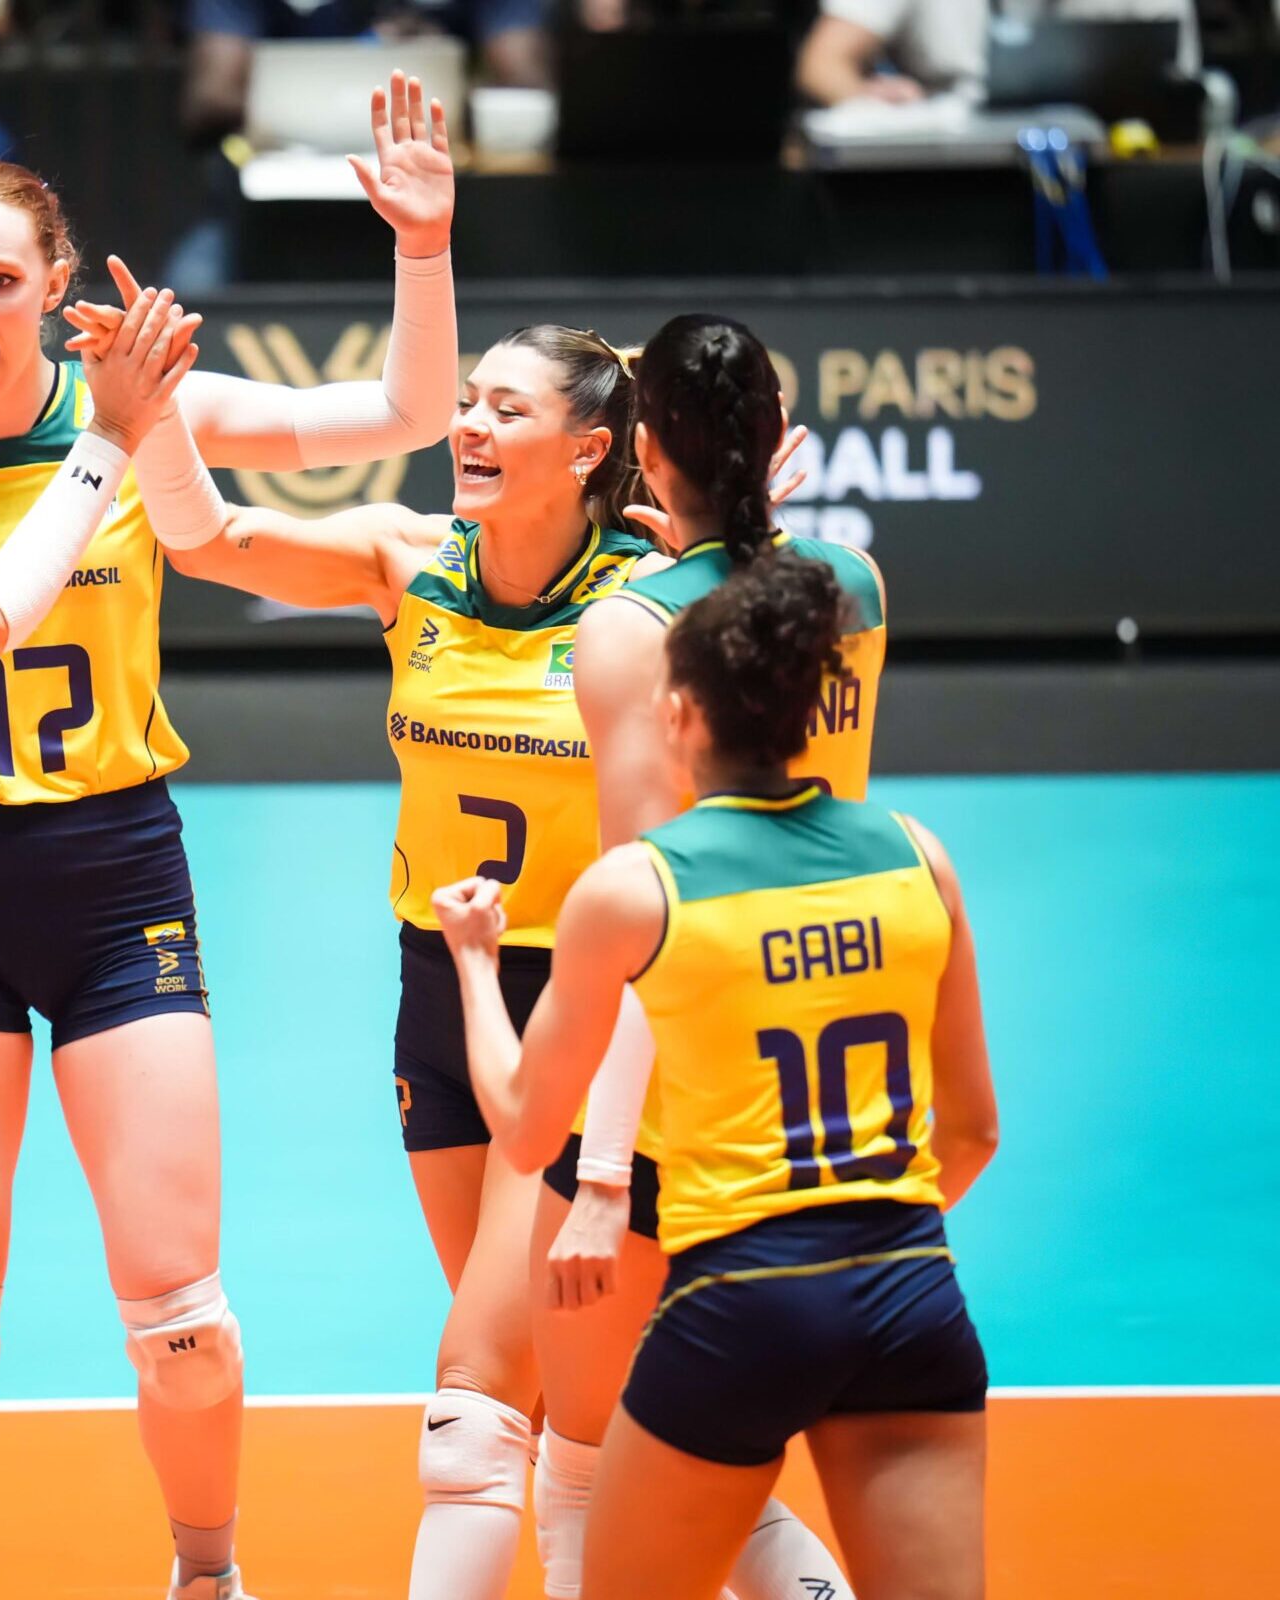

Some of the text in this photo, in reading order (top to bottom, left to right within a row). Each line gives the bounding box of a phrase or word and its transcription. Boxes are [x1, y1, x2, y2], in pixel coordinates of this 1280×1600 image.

[818, 346, 1038, 421] PARIS
[65, 567, 122, 588] RASIL
[408, 658, 431, 673] WORK
[411, 650, 433, 663] BODY
[410, 721, 590, 758] BANCO DO BRASIL
[761, 916, 883, 984] GABI
[154, 984, 188, 993] WORK
[156, 976, 185, 985] BODY
[757, 1011, 917, 1190] 10
